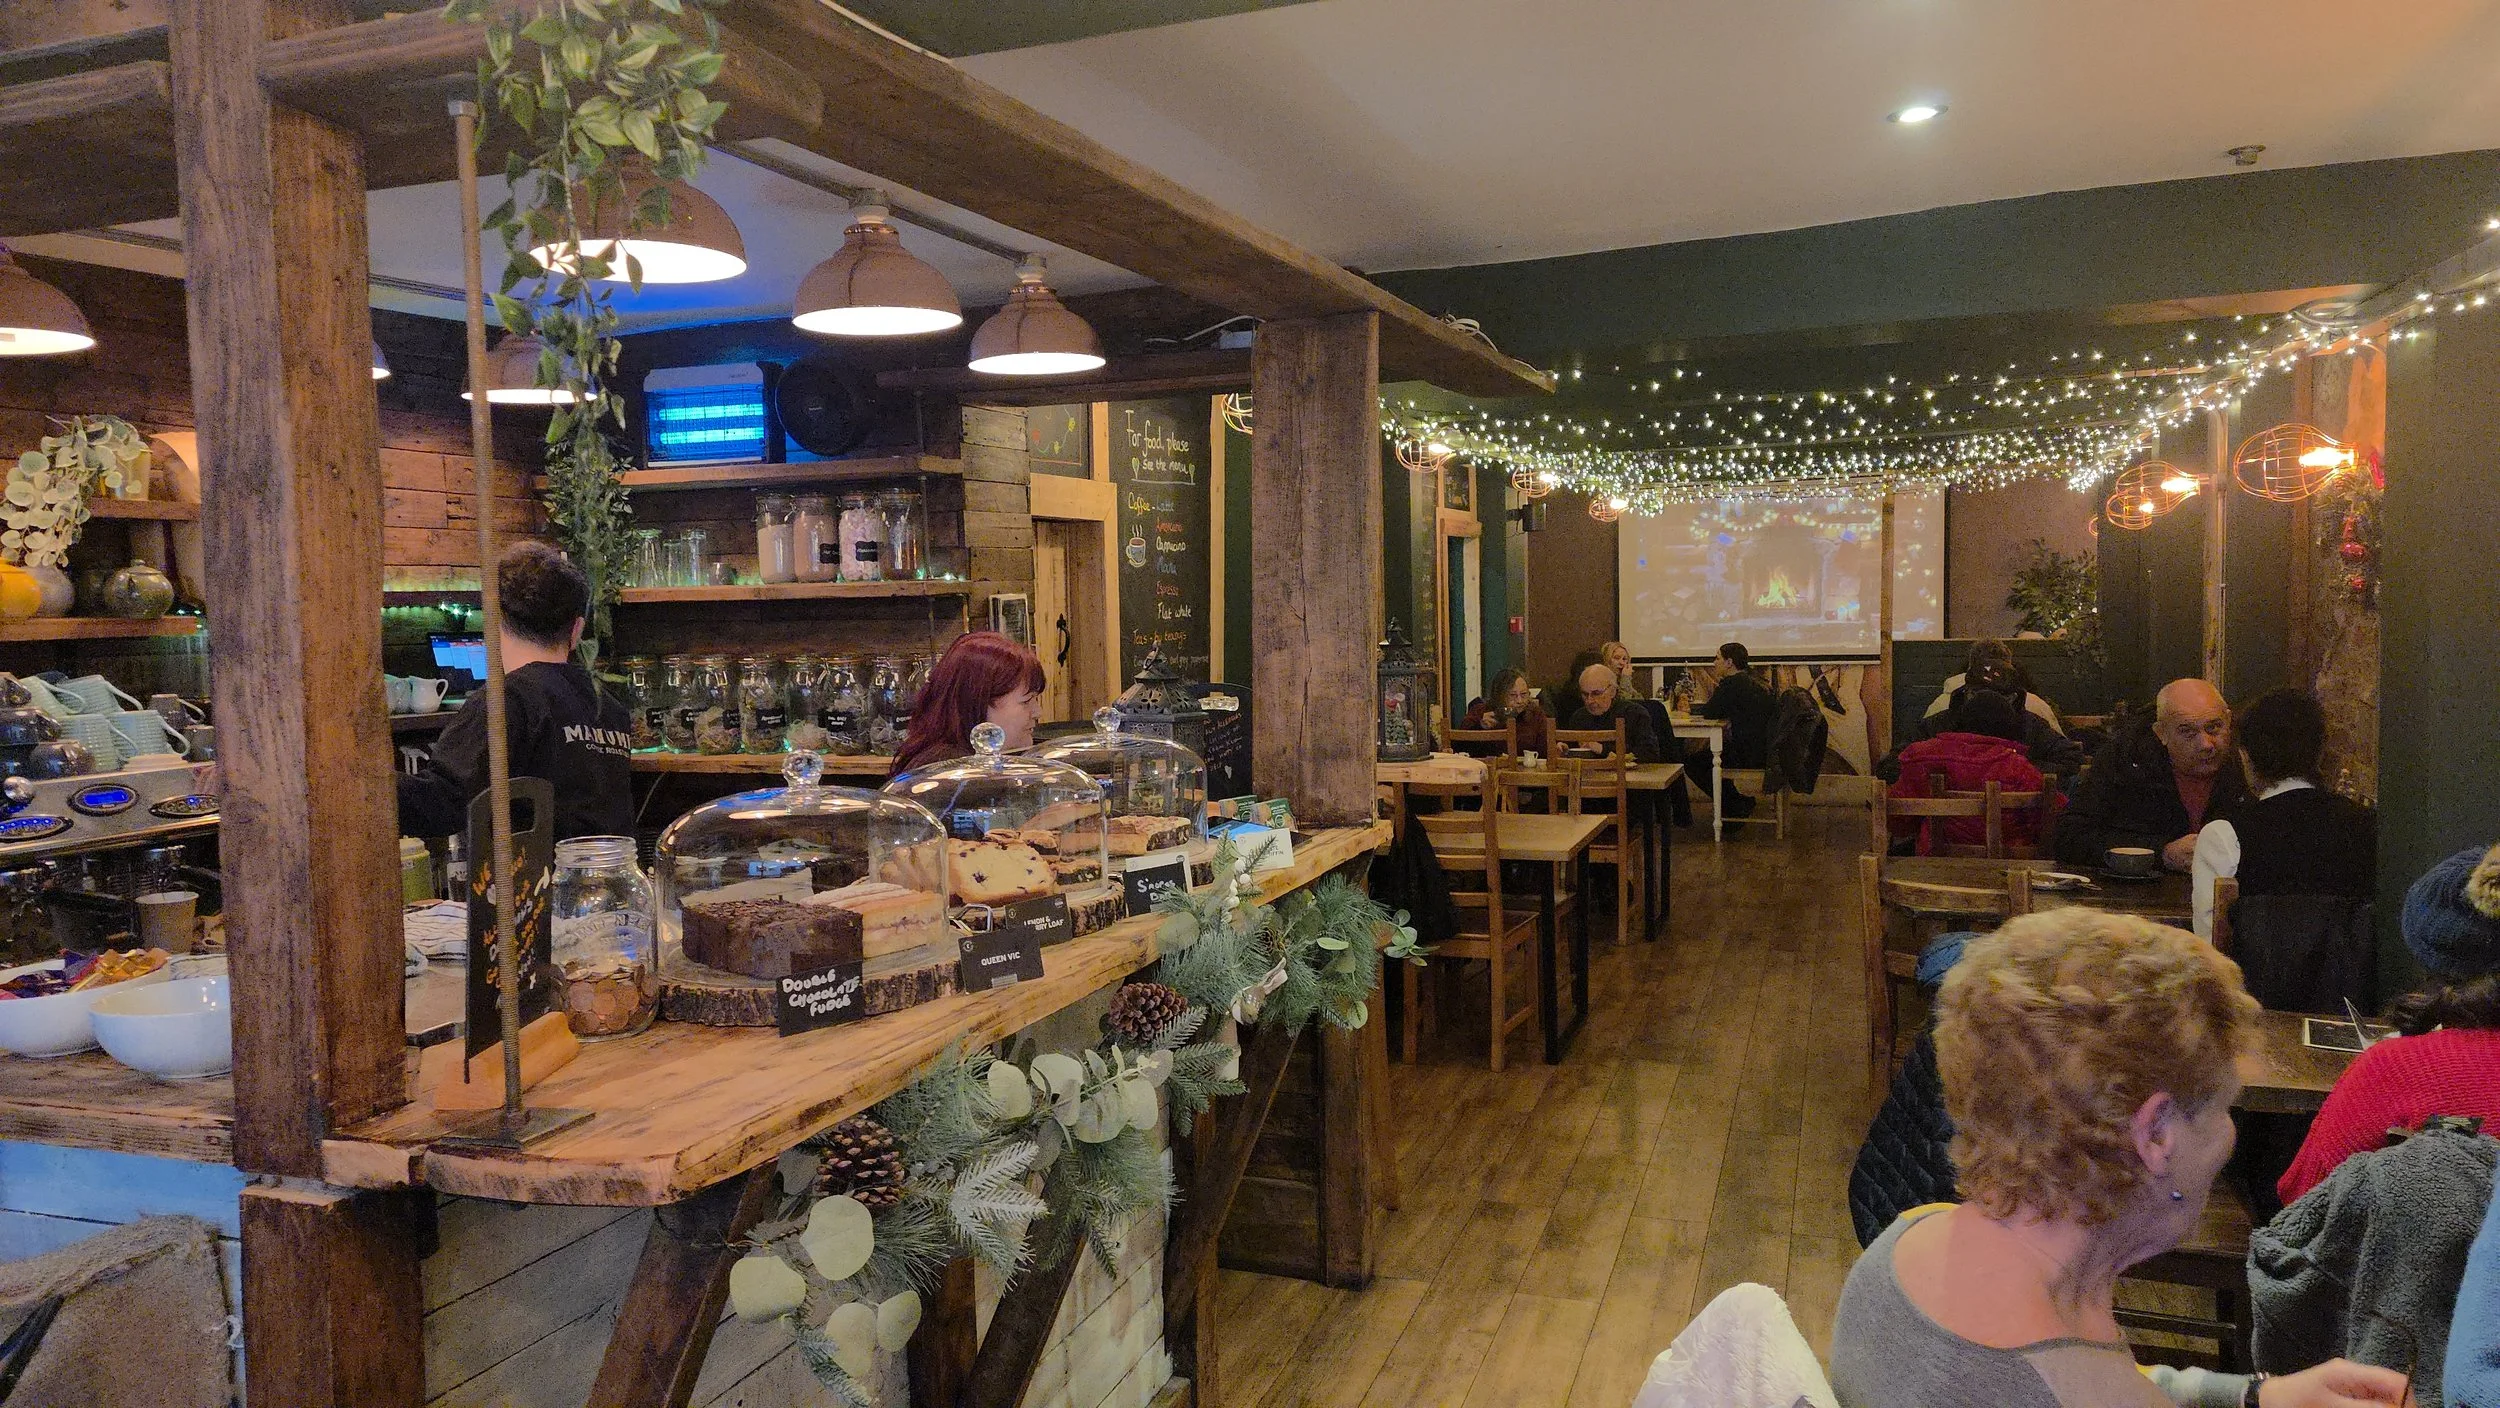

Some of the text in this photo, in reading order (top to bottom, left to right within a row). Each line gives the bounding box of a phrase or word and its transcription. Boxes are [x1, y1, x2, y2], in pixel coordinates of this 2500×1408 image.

[1125, 409, 1141, 447] For
[1167, 432, 1189, 456] please
[1156, 458, 1167, 471] the
[1169, 460, 1189, 474] menu
[1128, 491, 1150, 516] Coffee
[1157, 601, 1192, 620] Flat white
[1048, 918, 1065, 929] LOAF
[981, 951, 1021, 966] QUEEN VIC
[782, 968, 836, 993] DOUBLE
[788, 976, 861, 1008] CHOCOLATE
[810, 993, 852, 1017] FUDGE
